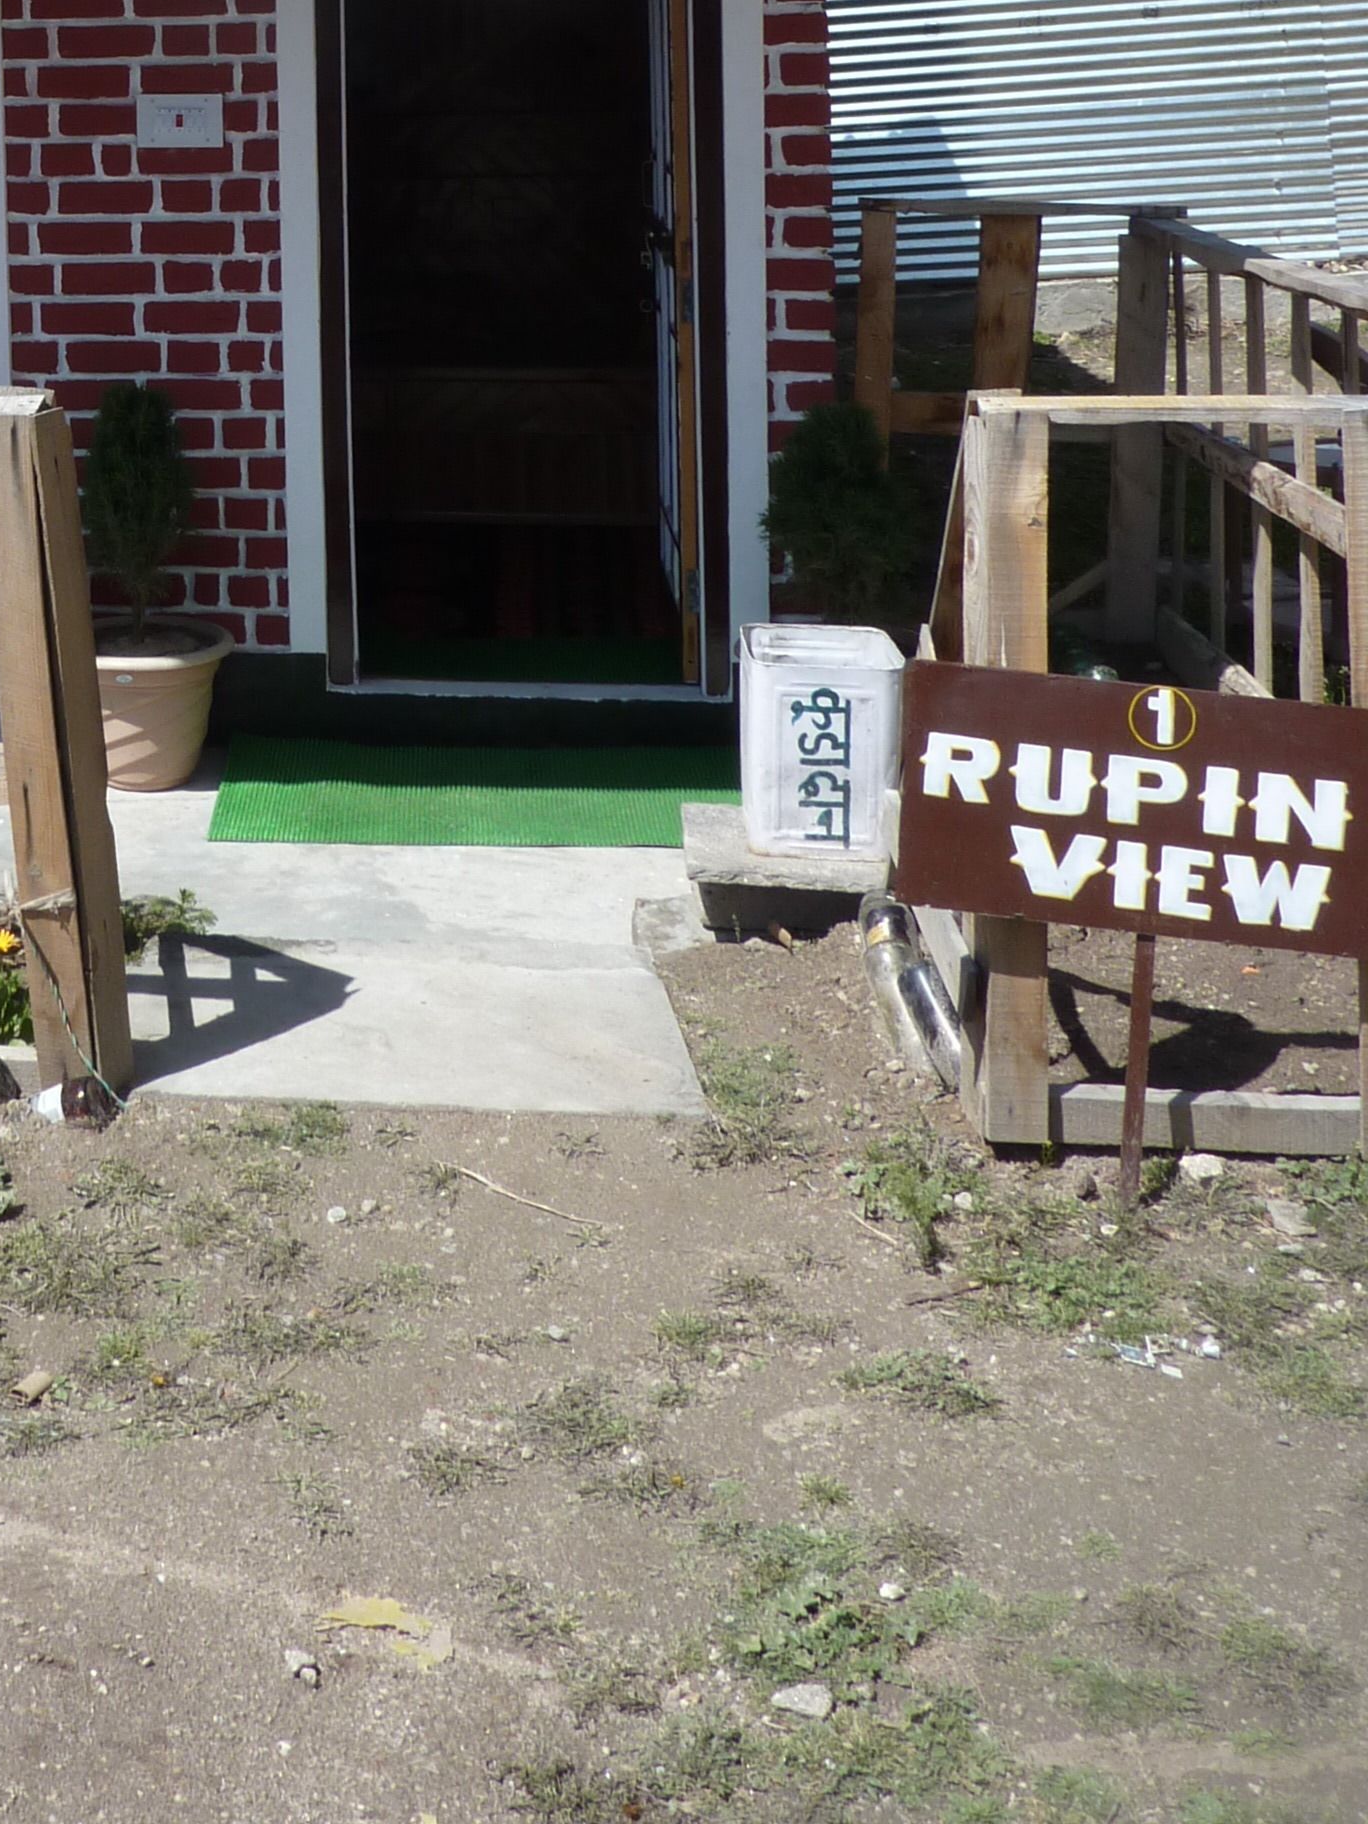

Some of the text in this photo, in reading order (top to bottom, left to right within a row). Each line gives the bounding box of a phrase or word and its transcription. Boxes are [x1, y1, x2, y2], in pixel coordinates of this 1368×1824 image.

[1147, 687, 1174, 745] 1
[920, 732, 1352, 851] RUPIN
[1010, 825, 1331, 932] VIEW
